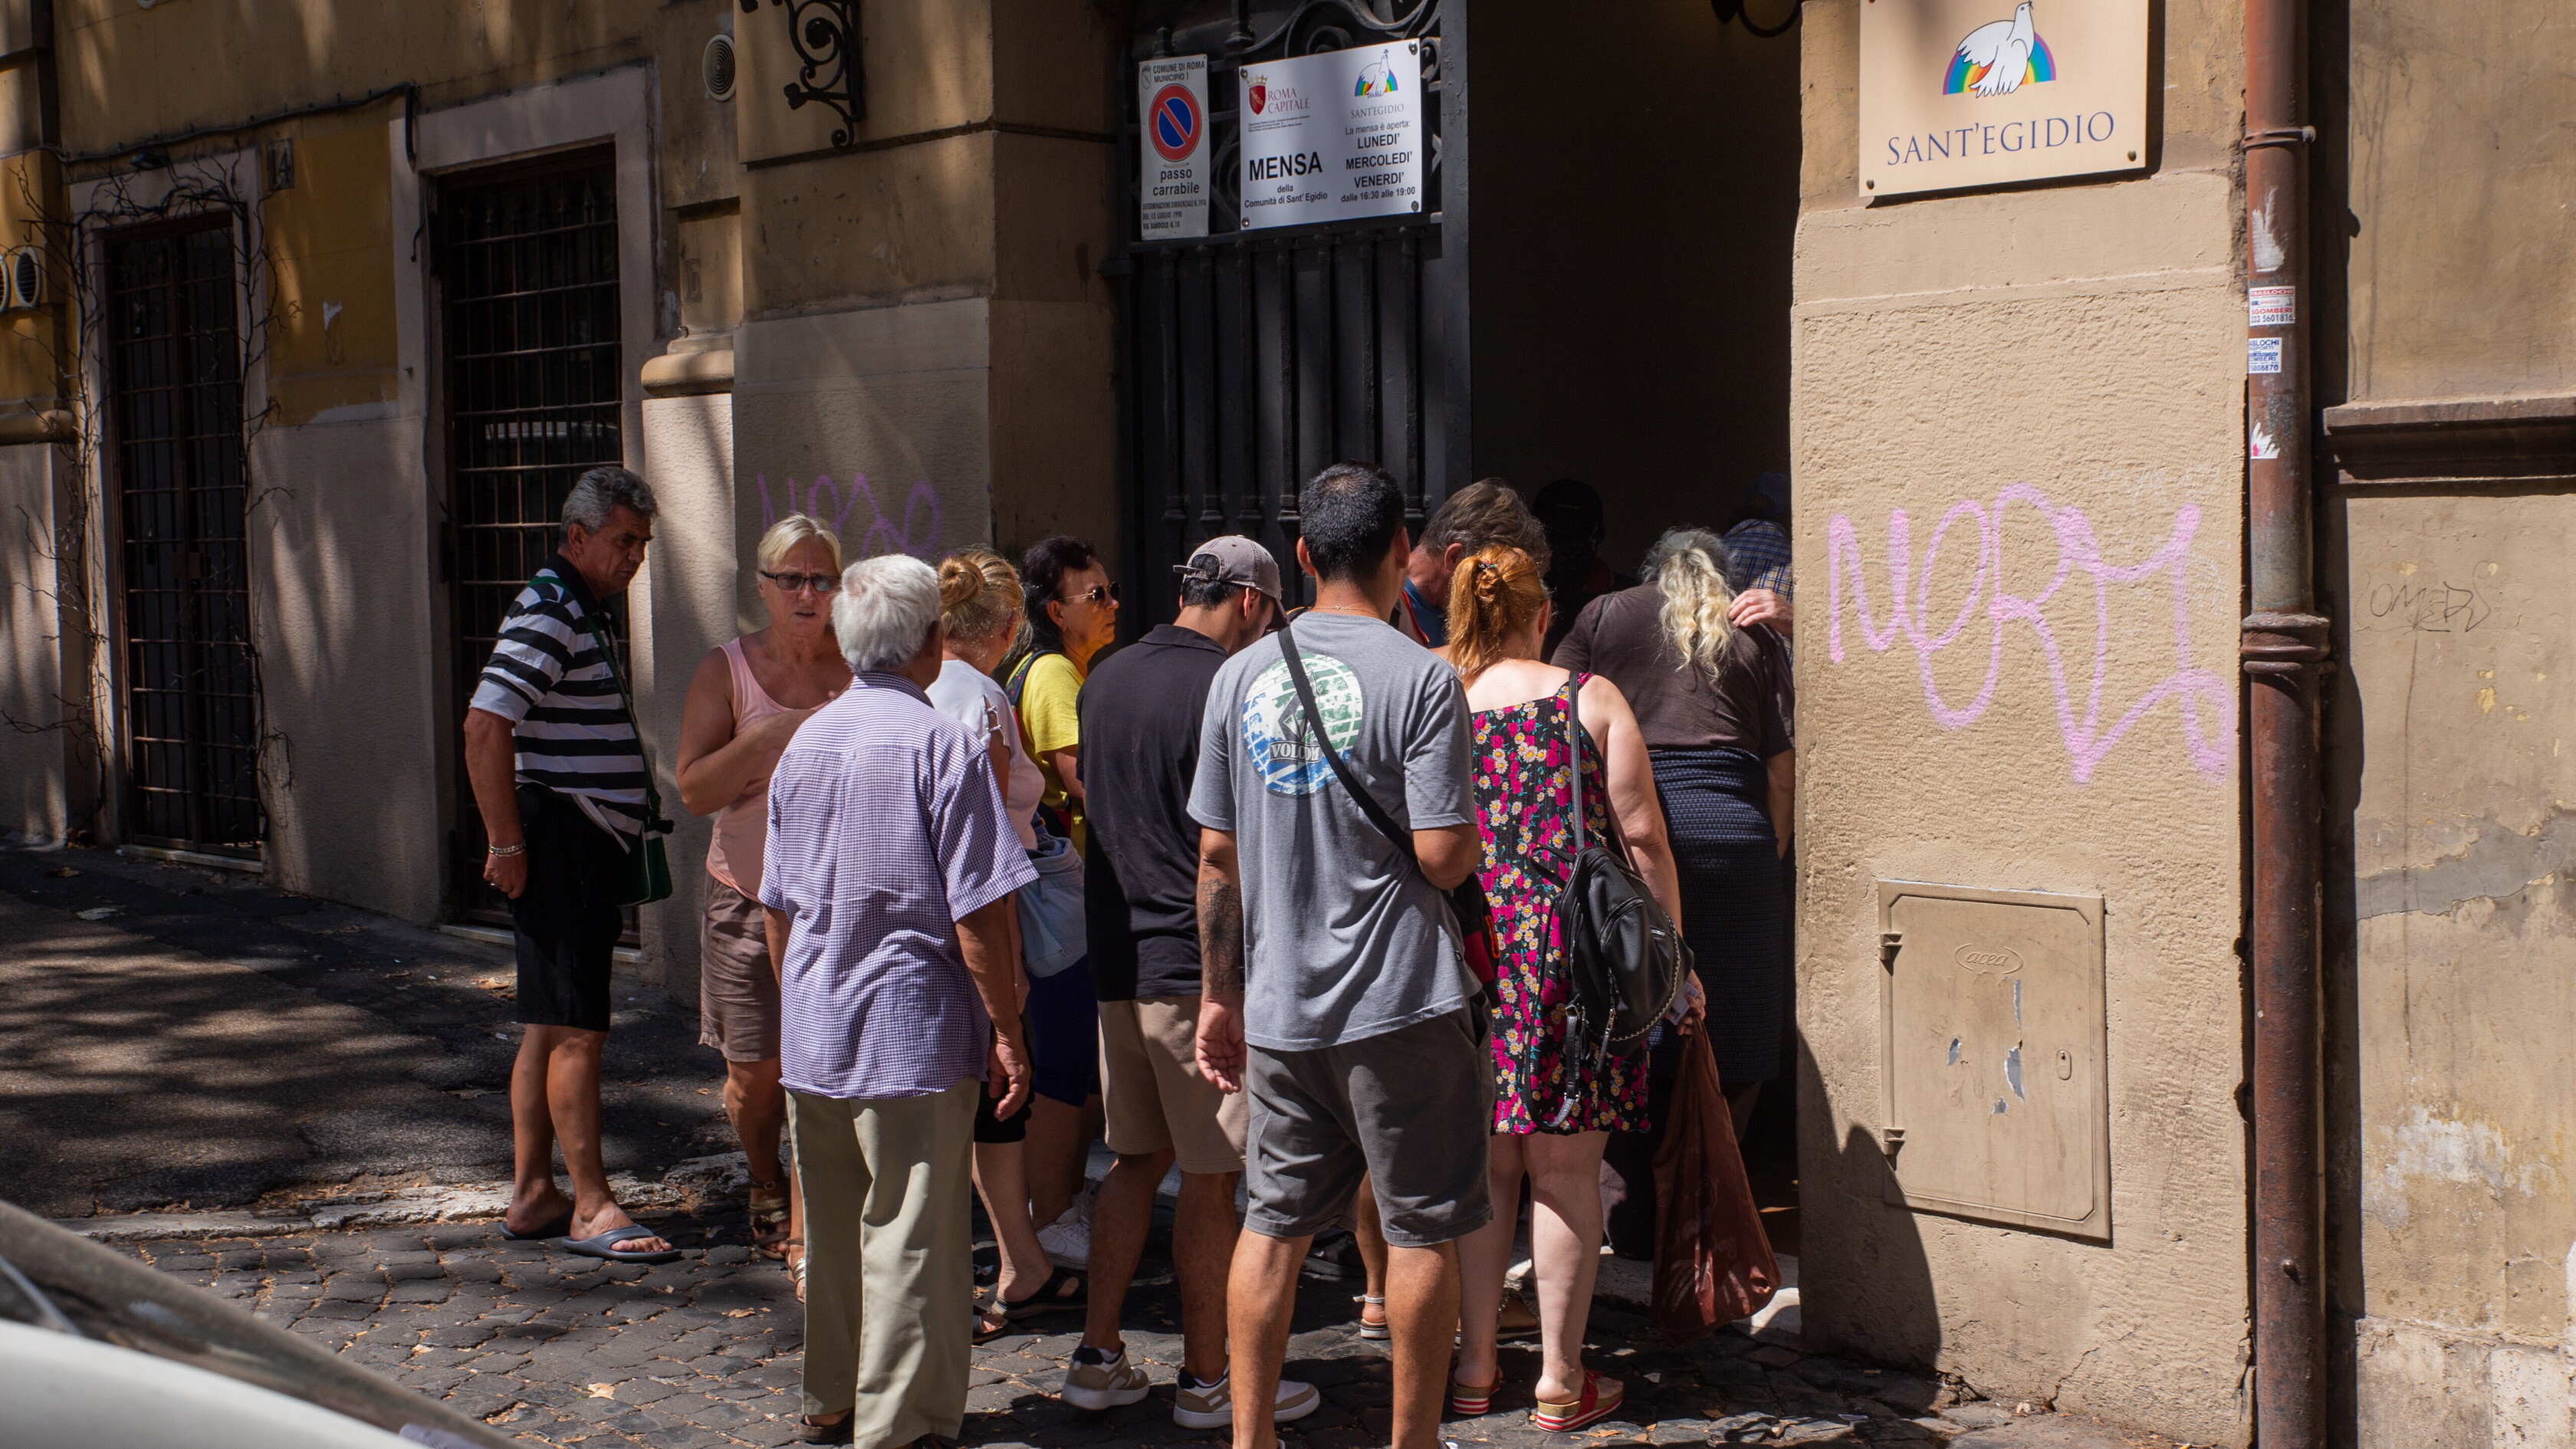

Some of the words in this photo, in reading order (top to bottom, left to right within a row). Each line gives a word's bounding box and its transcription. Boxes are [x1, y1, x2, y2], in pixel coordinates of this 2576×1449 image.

[1153, 64, 1178, 74] COMUNE
[1178, 62, 1185, 71] DI
[1187, 61, 1205, 71] ROMA
[1154, 73, 1184, 83] MUNICIPIO
[1186, 71, 1189, 80] I
[1267, 87, 1297, 101] ROMA
[1267, 97, 1310, 113] CAPITALE
[1351, 104, 1405, 119] SANT'EGIDIO
[1346, 127, 1354, 135] La
[1355, 124, 1378, 134] mensa
[1380, 122, 1385, 130] è
[1387, 120, 1411, 131] aperta:
[1357, 133, 1400, 149] LUNEDI'
[1887, 110, 2115, 166] SANT'EGIDIO
[1249, 151, 1323, 182] MENSA
[1346, 151, 1413, 170] MERCOLEDI'
[1161, 169, 1192, 183] passo
[1354, 172, 1405, 189] VENERDI'
[1153, 182, 1200, 196] carrabile
[1277, 184, 1293, 193] della
[1341, 194, 1358, 202] dalle
[1360, 191, 1379, 201] 16:30
[1381, 189, 1394, 199] alle
[1396, 186, 1416, 196] 19:00
[1244, 196, 1276, 208] Comunità
[1278, 196, 1285, 205] di
[1286, 194, 1304, 204] Sant'
[1306, 192, 1328, 202] Egidio
[1157, 211, 1171, 219] LUGLIO
[1151, 222, 1169, 230] DANDOLO
[2252, 307, 2292, 315] SGOMBERI
[2262, 314, 2293, 322] 5601816
[1270, 742, 1321, 761] VOLCOM
[1965, 951, 2009, 967] acea
